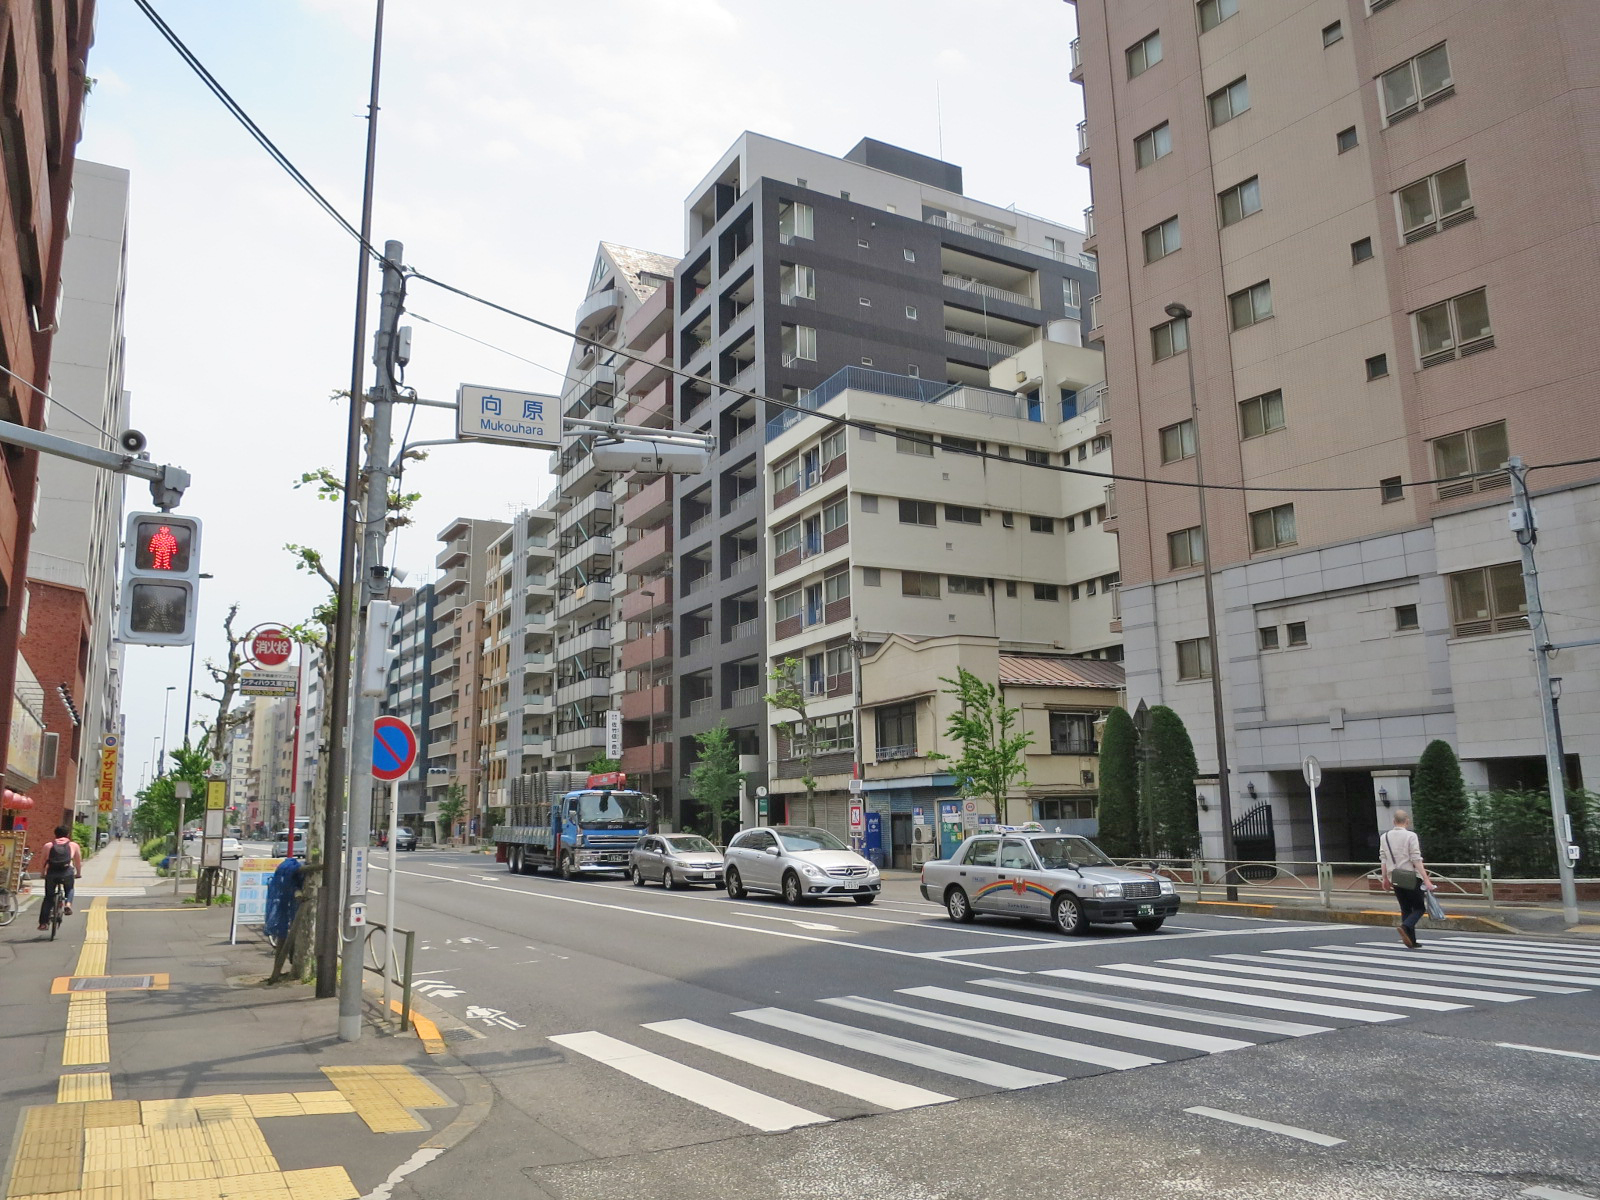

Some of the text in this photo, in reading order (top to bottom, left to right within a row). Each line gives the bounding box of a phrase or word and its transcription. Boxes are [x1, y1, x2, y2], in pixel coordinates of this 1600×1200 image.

[480, 418, 544, 436] Mukouhara
[255, 640, 289, 655] 消火栓
[101, 749, 116, 802] アサヒ弓具
